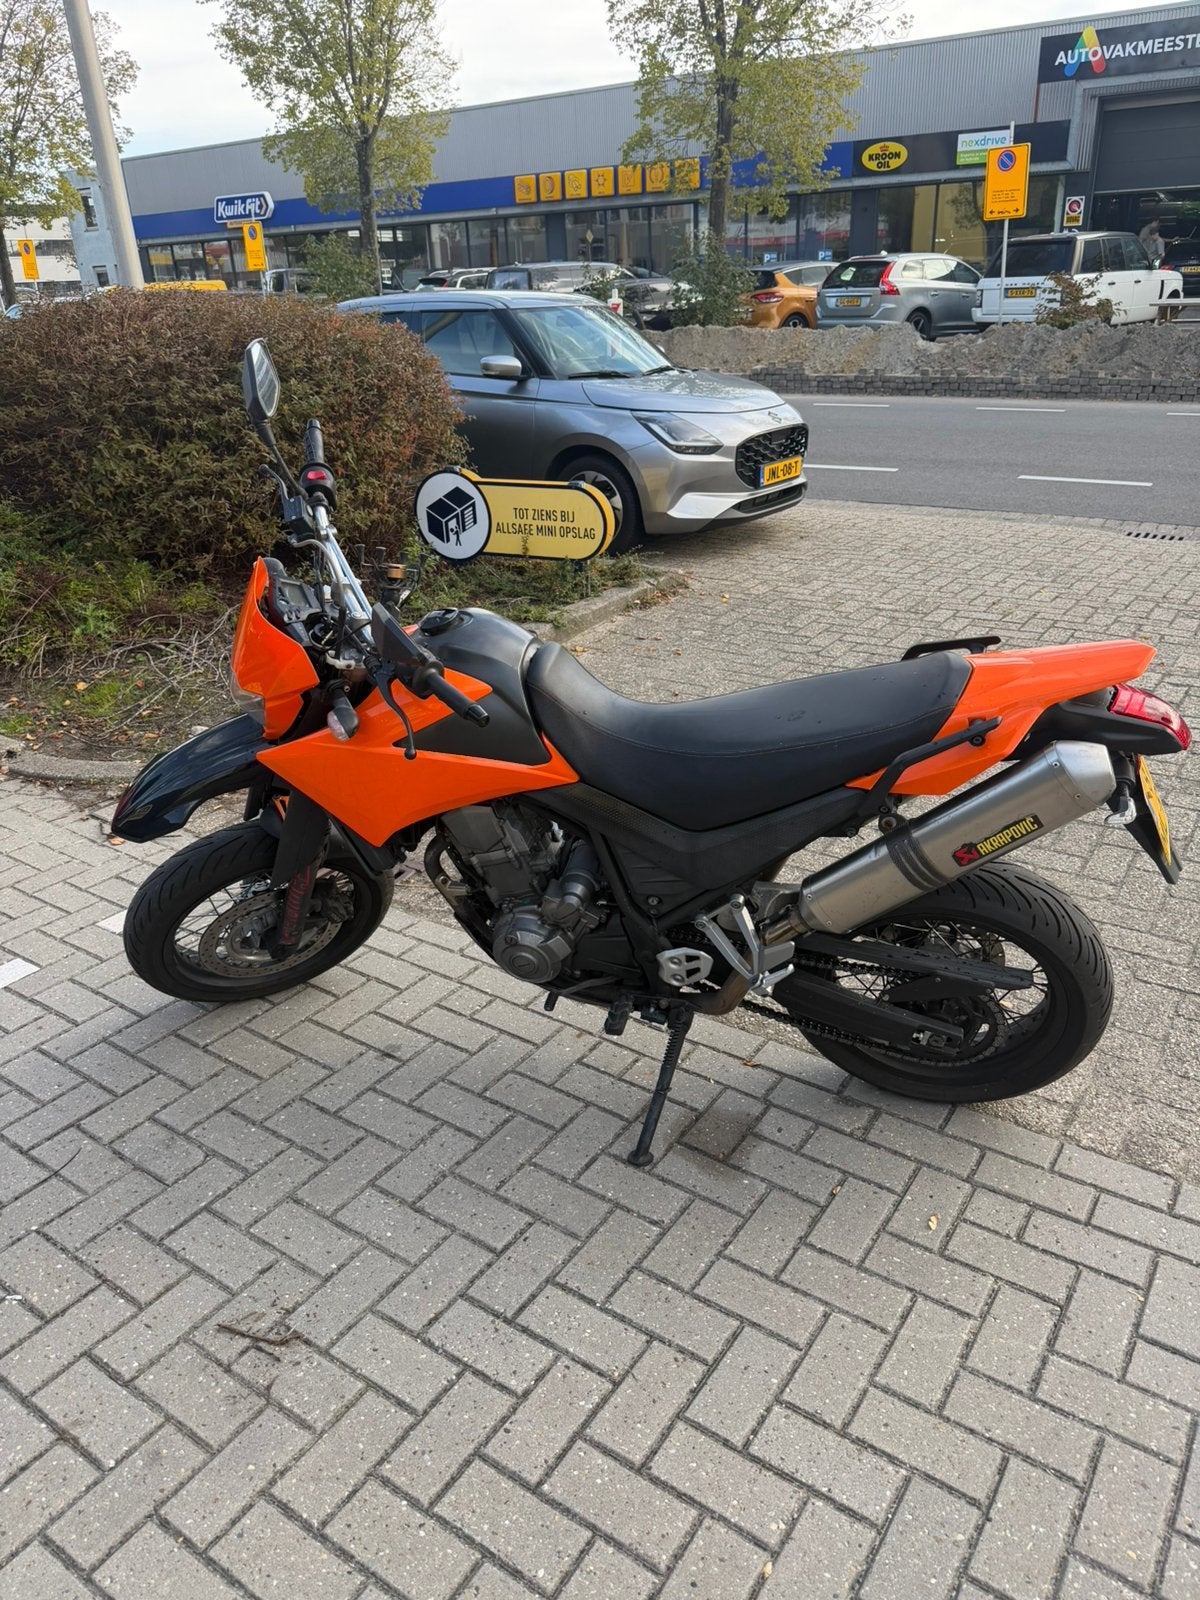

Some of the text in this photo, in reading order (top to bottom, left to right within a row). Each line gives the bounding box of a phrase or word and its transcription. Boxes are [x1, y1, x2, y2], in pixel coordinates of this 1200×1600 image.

[960, 134, 1007, 149] nexdrive
[868, 151, 901, 162] KROON
[876, 160, 891, 169] OIL
[766, 460, 799, 482] JNL-08-T
[513, 507, 575, 523] TOT ZIENS BIJ
[496, 522, 596, 540] ALLSAFE MINI OPSLAG
